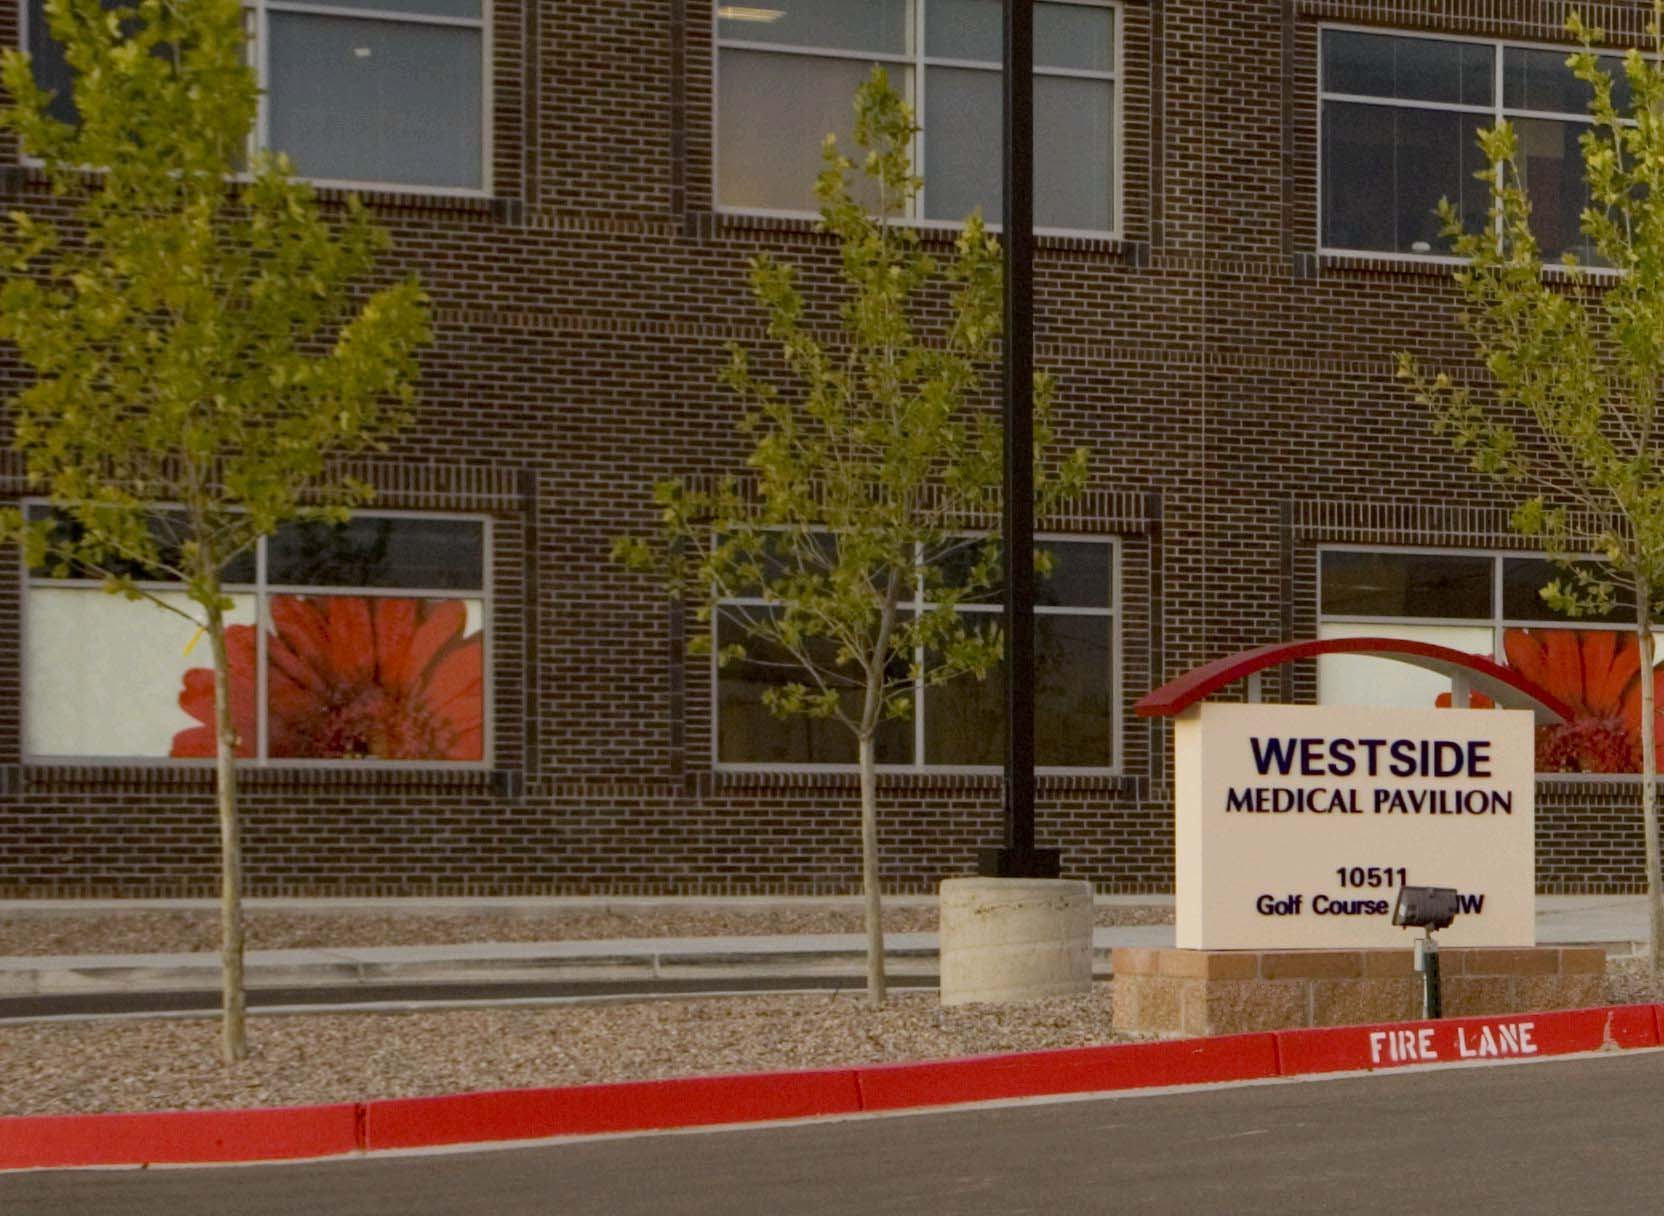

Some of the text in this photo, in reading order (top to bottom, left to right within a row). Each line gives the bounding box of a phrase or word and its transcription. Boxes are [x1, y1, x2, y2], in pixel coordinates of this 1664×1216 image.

[1250, 737, 1492, 778] WESTSIDE
[1225, 787, 1513, 815] MEDICAL PAVILION
[1336, 867, 1407, 888] 10511
[1256, 894, 1302, 916] Golf
[1312, 894, 1390, 916] Course
[1370, 1022, 1538, 1063] FIRE LANE
